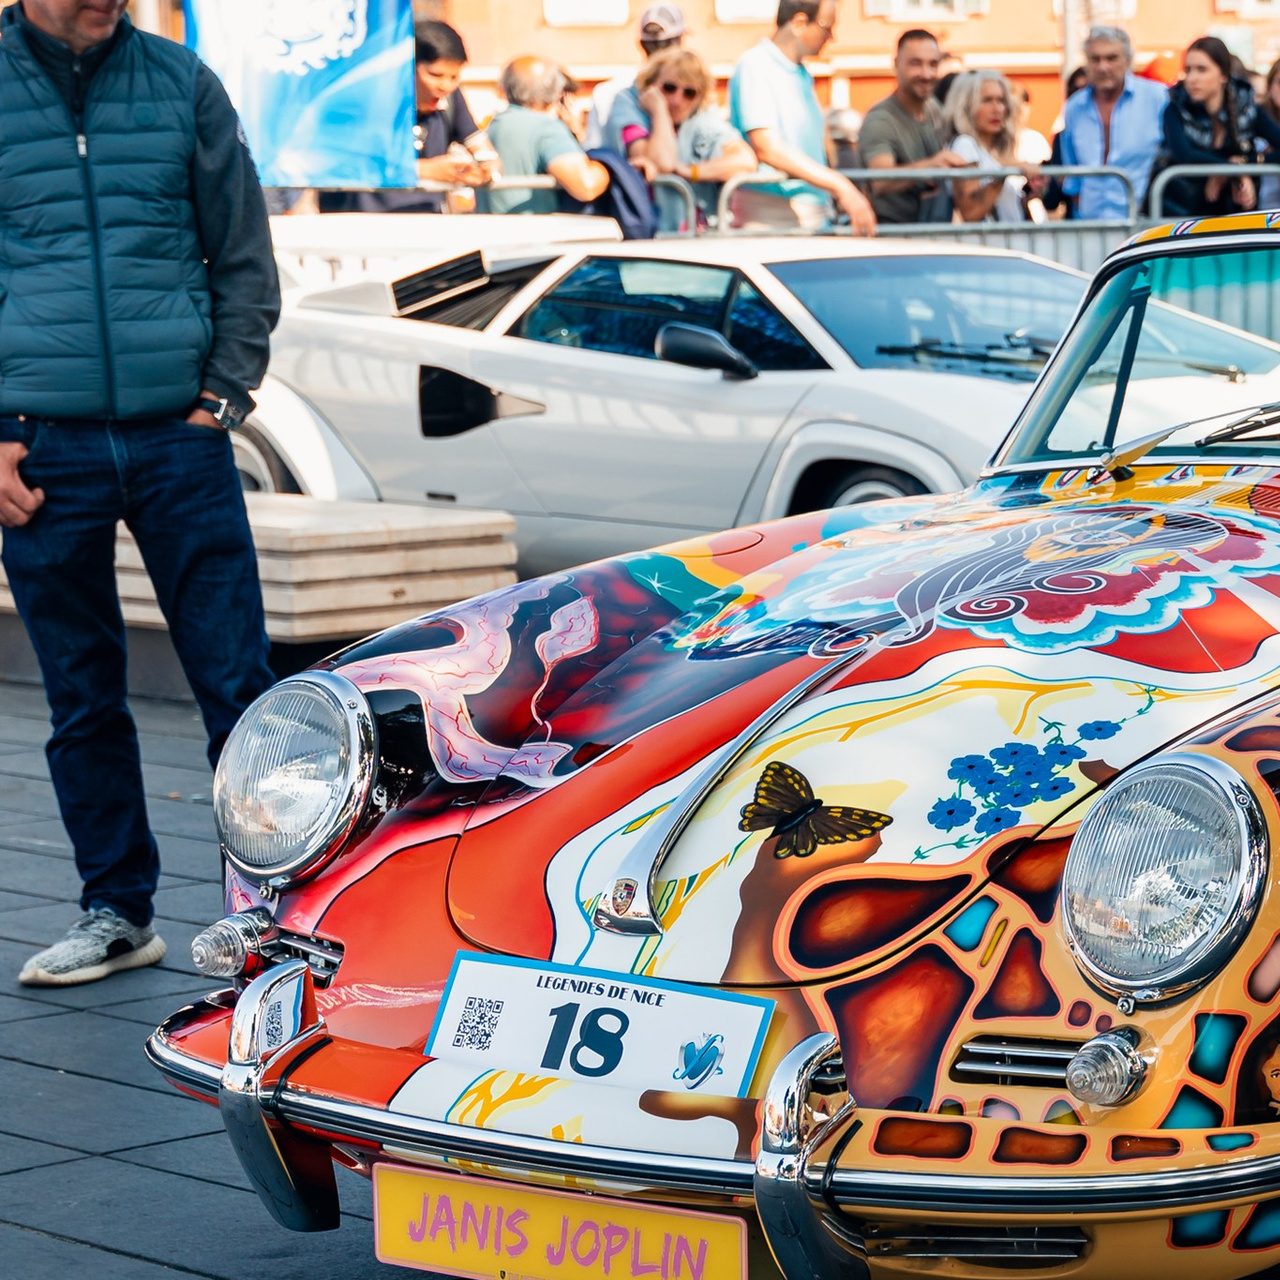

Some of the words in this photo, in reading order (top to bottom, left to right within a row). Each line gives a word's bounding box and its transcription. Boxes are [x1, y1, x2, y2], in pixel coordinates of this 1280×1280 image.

[536, 975, 606, 996] LEGENDES
[607, 985, 630, 1001] DE
[630, 989, 667, 1008] NICE
[540, 1002, 630, 1077] 18
[408, 1192, 530, 1258] JANIS
